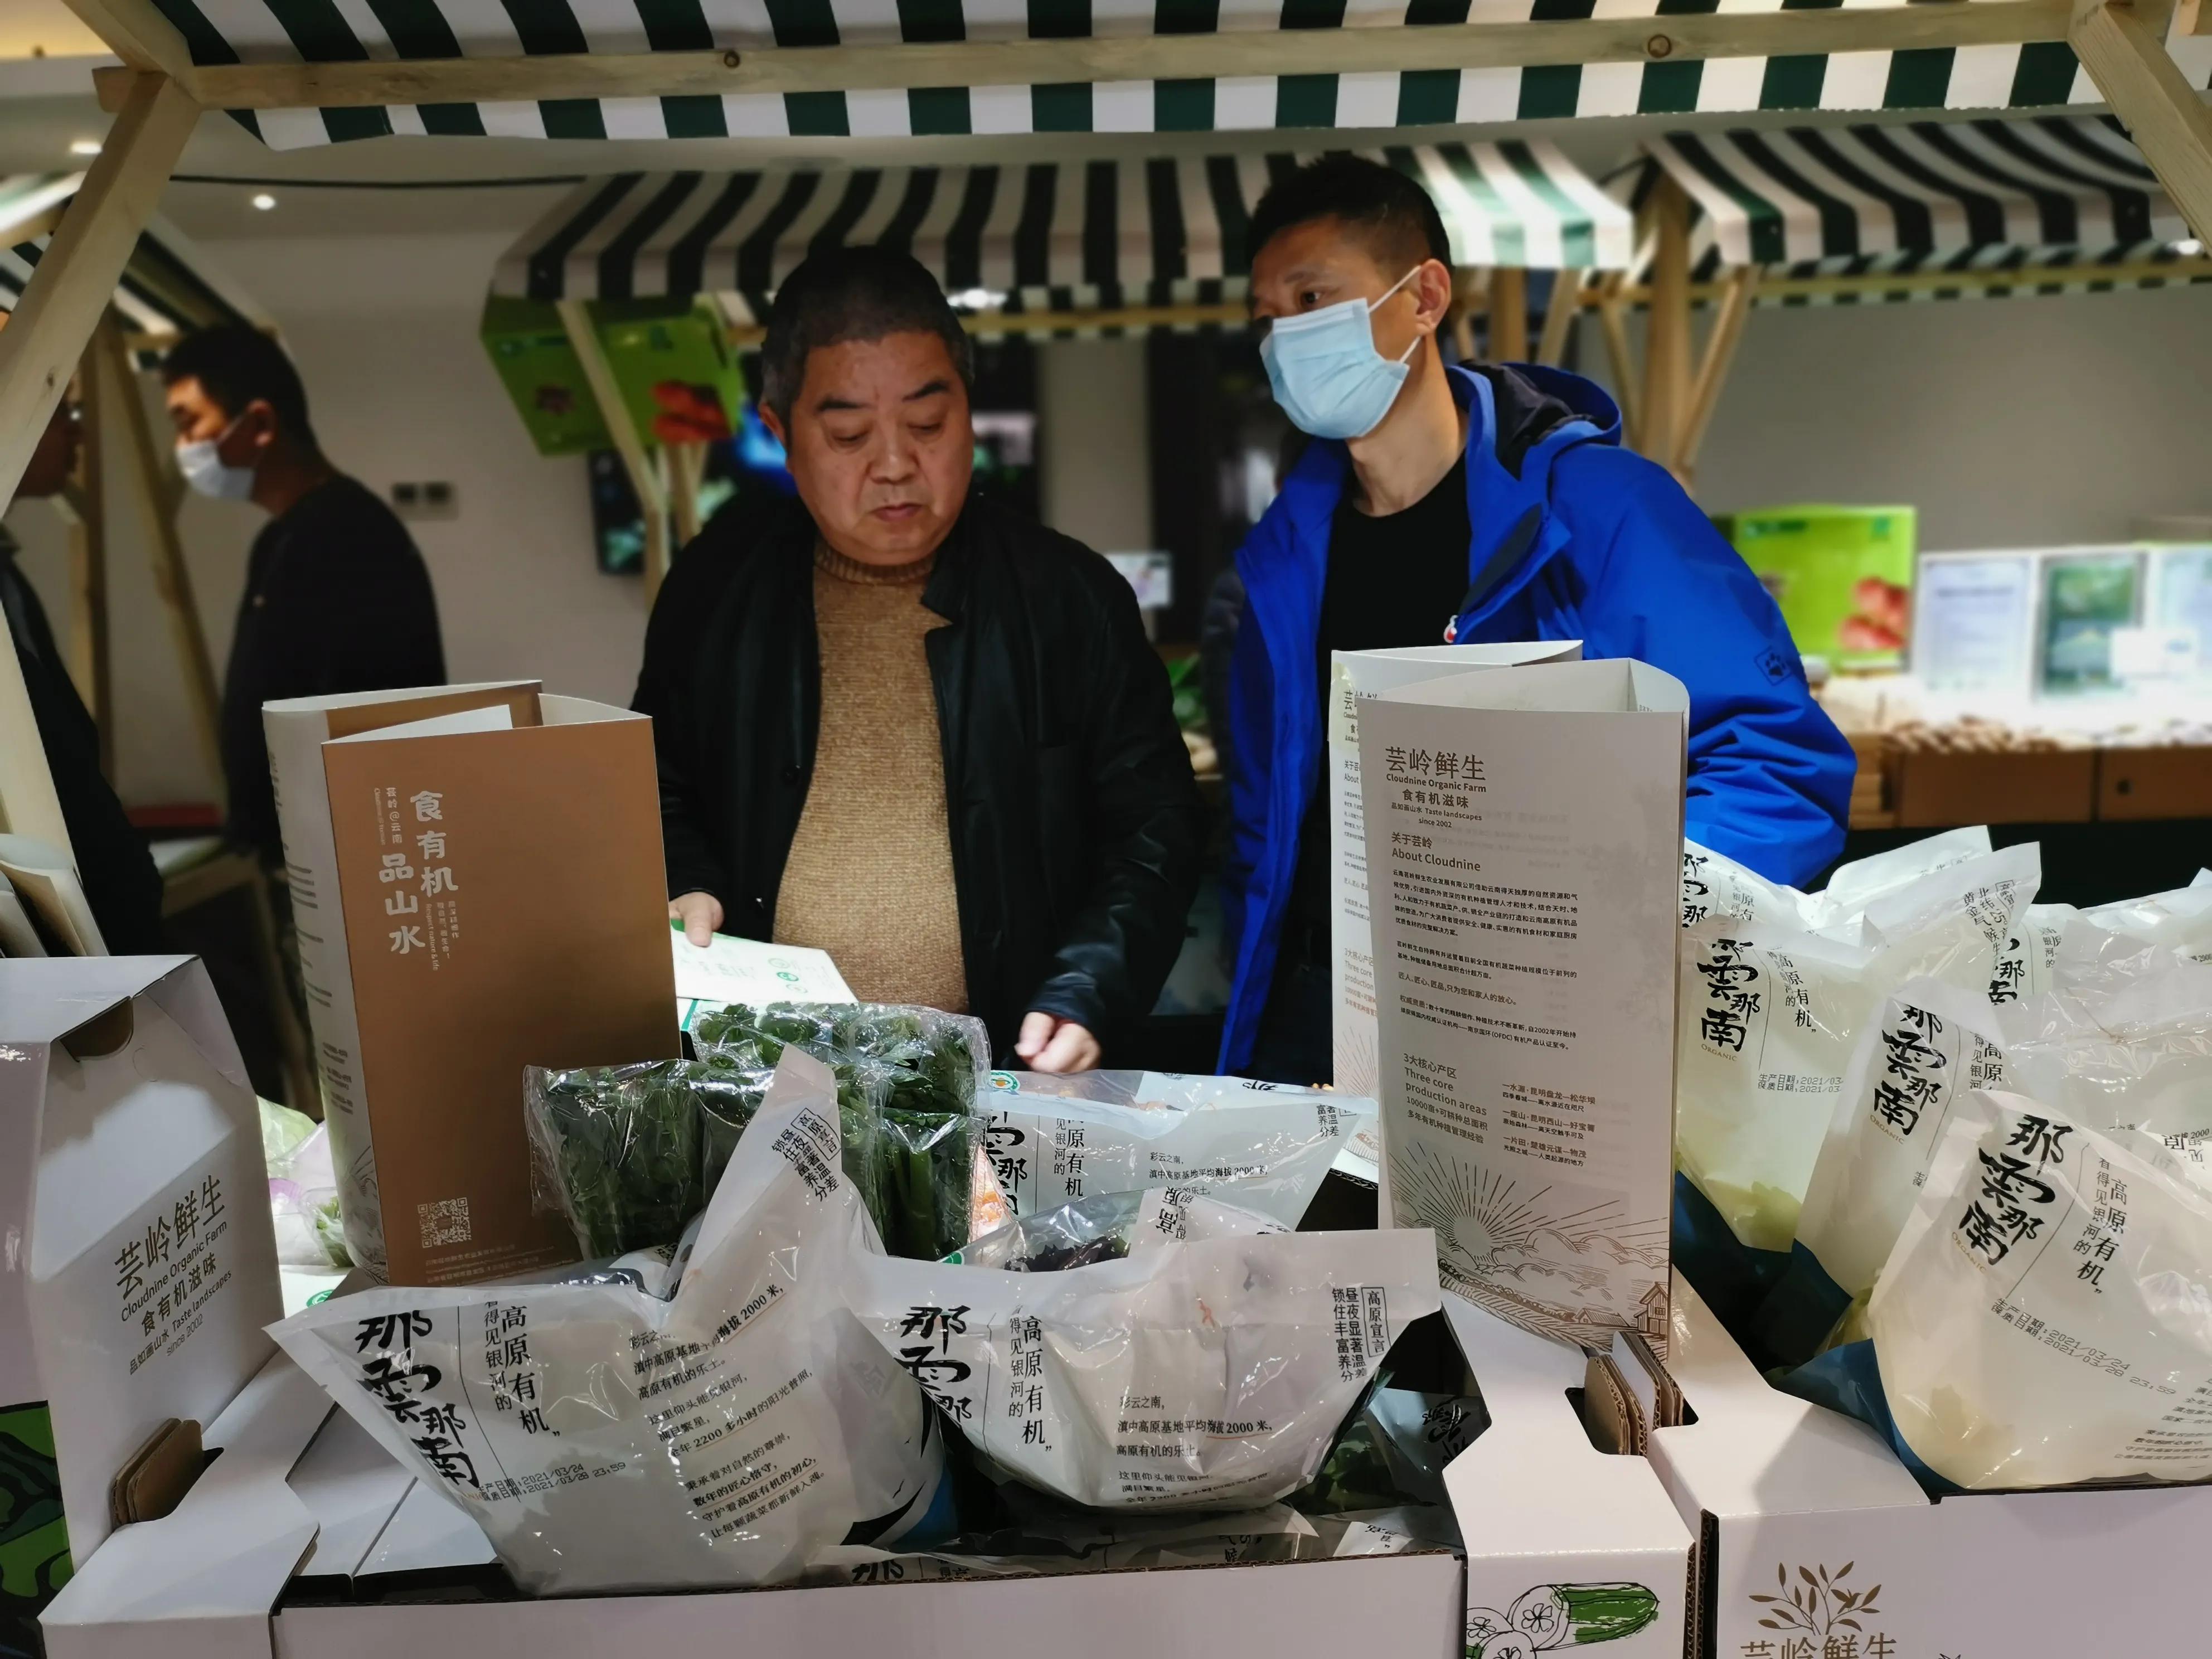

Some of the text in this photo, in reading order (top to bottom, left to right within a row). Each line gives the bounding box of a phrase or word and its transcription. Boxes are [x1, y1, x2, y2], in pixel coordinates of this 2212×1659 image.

[1385, 746, 1487, 782] 芸岭鲜生
[1386, 773, 1487, 793] Cloudnine Organic Farm
[1401, 788, 1469, 809] 食有机滋味
[1418, 817, 1452, 828] since 2002
[1425, 808, 1442, 817] Taste
[1443, 810, 1482, 822] landscapes
[410, 790, 459, 898] 食有机
[1391, 831, 1433, 849] 关于芸岭
[1391, 847, 1481, 872] About Cloudnine
[379, 853, 426, 955] 品山水
[1360, 967, 1372, 978] core
[1403, 1052, 1457, 1079] 3大核心产区
[1701, 1043, 1738, 1062] ORGANIC
[1404, 1066, 1454, 1092] Three core
[1405, 1082, 1487, 1116] production areas
[1407, 1109, 1485, 1144] 多年有机种植管理经验
[1869, 1114, 1905, 1145] ORGANIC
[114, 1175, 225, 1301] 芸岭鲜生
[1951, 1231, 1987, 1274] ORGANIC
[121, 1220, 227, 1322] Cloudnine Organic Farm
[141, 1251, 217, 1337] 食有机滋味
[172, 1308, 192, 1333] Taste
[192, 1269, 232, 1312] landscapes
[740, 1294, 768, 1321] 2000
[166, 1313, 204, 1357] since 2002
[1331, 1288, 1355, 1383] 锁住丰富养分
[1366, 1290, 1385, 1354] 高原宣言
[693, 1428, 723, 1448] 2200
[1226, 1422, 1254, 1434] 2000
[593, 1461, 627, 1478] 23:59
